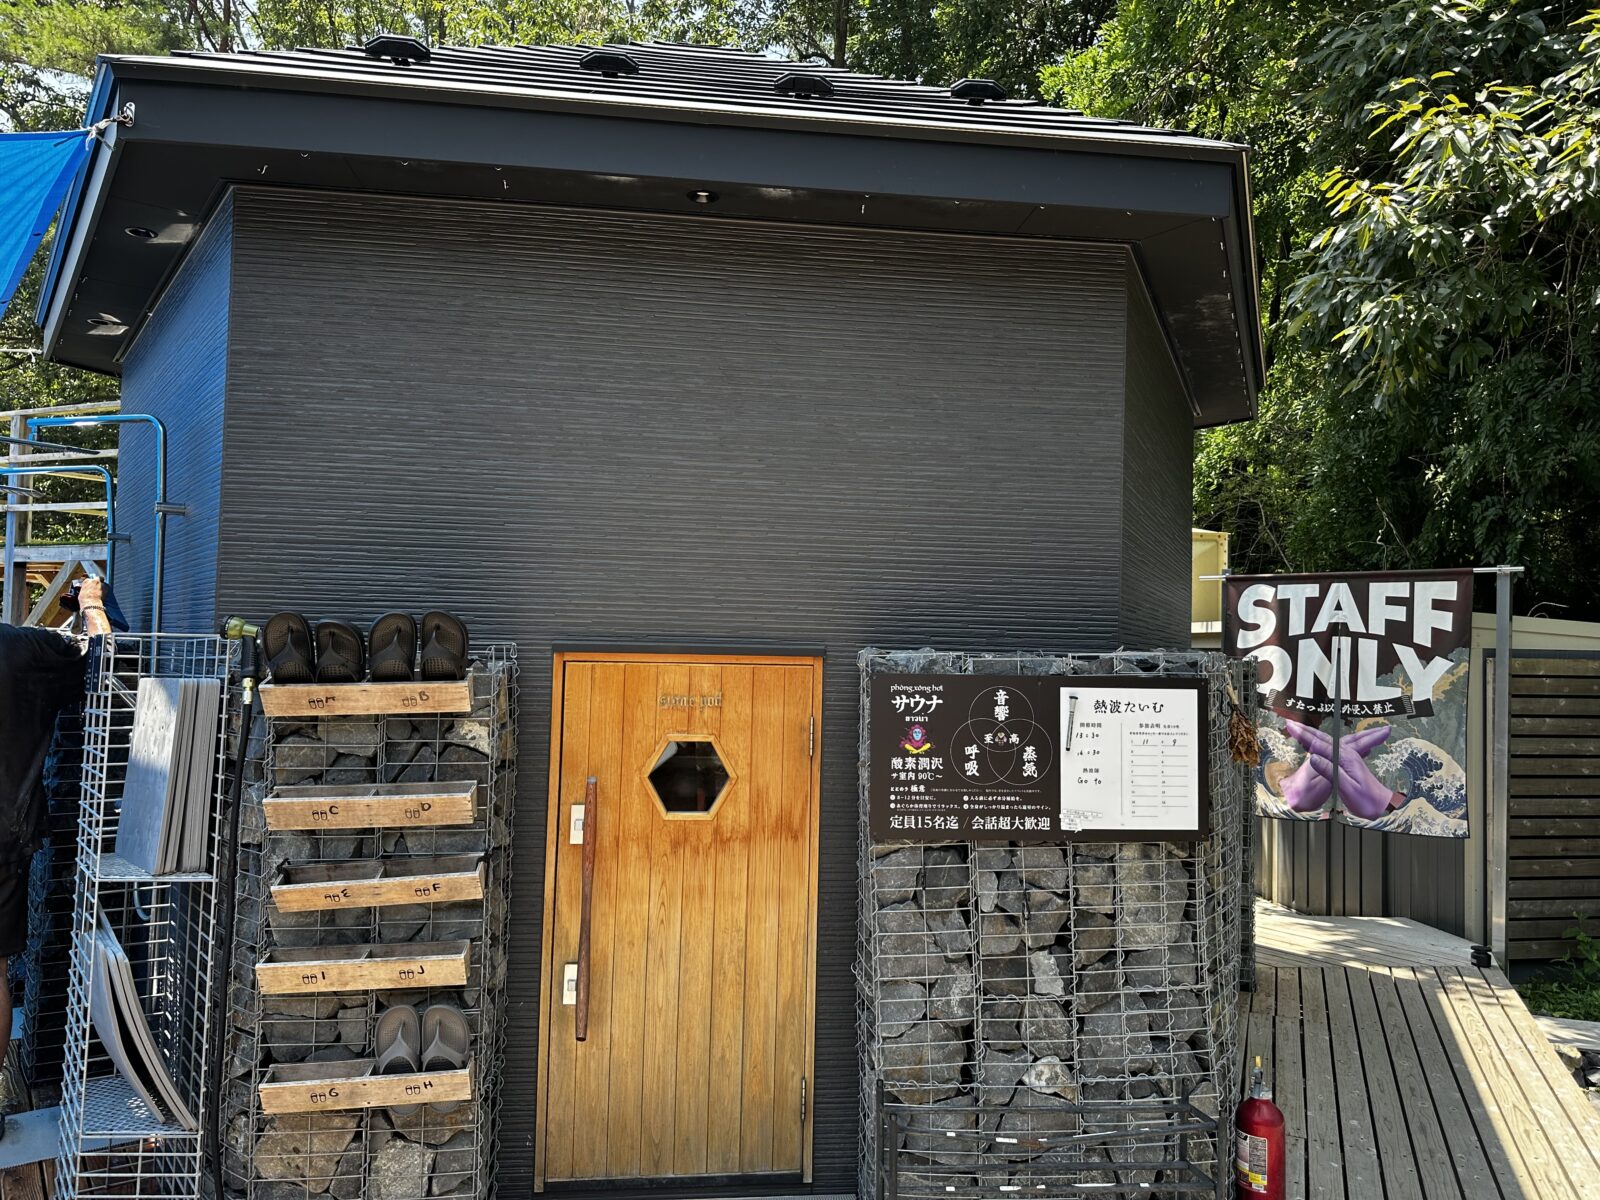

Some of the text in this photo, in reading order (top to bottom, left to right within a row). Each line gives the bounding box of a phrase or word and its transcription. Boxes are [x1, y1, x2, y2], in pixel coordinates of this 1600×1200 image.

[1237, 581, 1458, 648] STAFF
[1242, 636, 1455, 701] ONLY
[419, 691, 430, 701] B
[891, 694, 944, 713] サウナ
[994, 689, 1010, 721] 音響
[1093, 699, 1164, 714] 熱波たいむ
[891, 756, 944, 770] 酸素潤沢
[964, 744, 980, 777] 呼吸
[1022, 746, 1038, 778] 蒸気
[329, 805, 339, 815] C
[420, 802, 432, 812] D
[889, 815, 959, 830] 定員15名迄
[971, 816, 1051, 830] 会話超大歓迎
[340, 888, 351, 898] E
[432, 882, 441, 892] F
[417, 965, 425, 975] J
[328, 1087, 339, 1097] G
[423, 1081, 433, 1089] H
